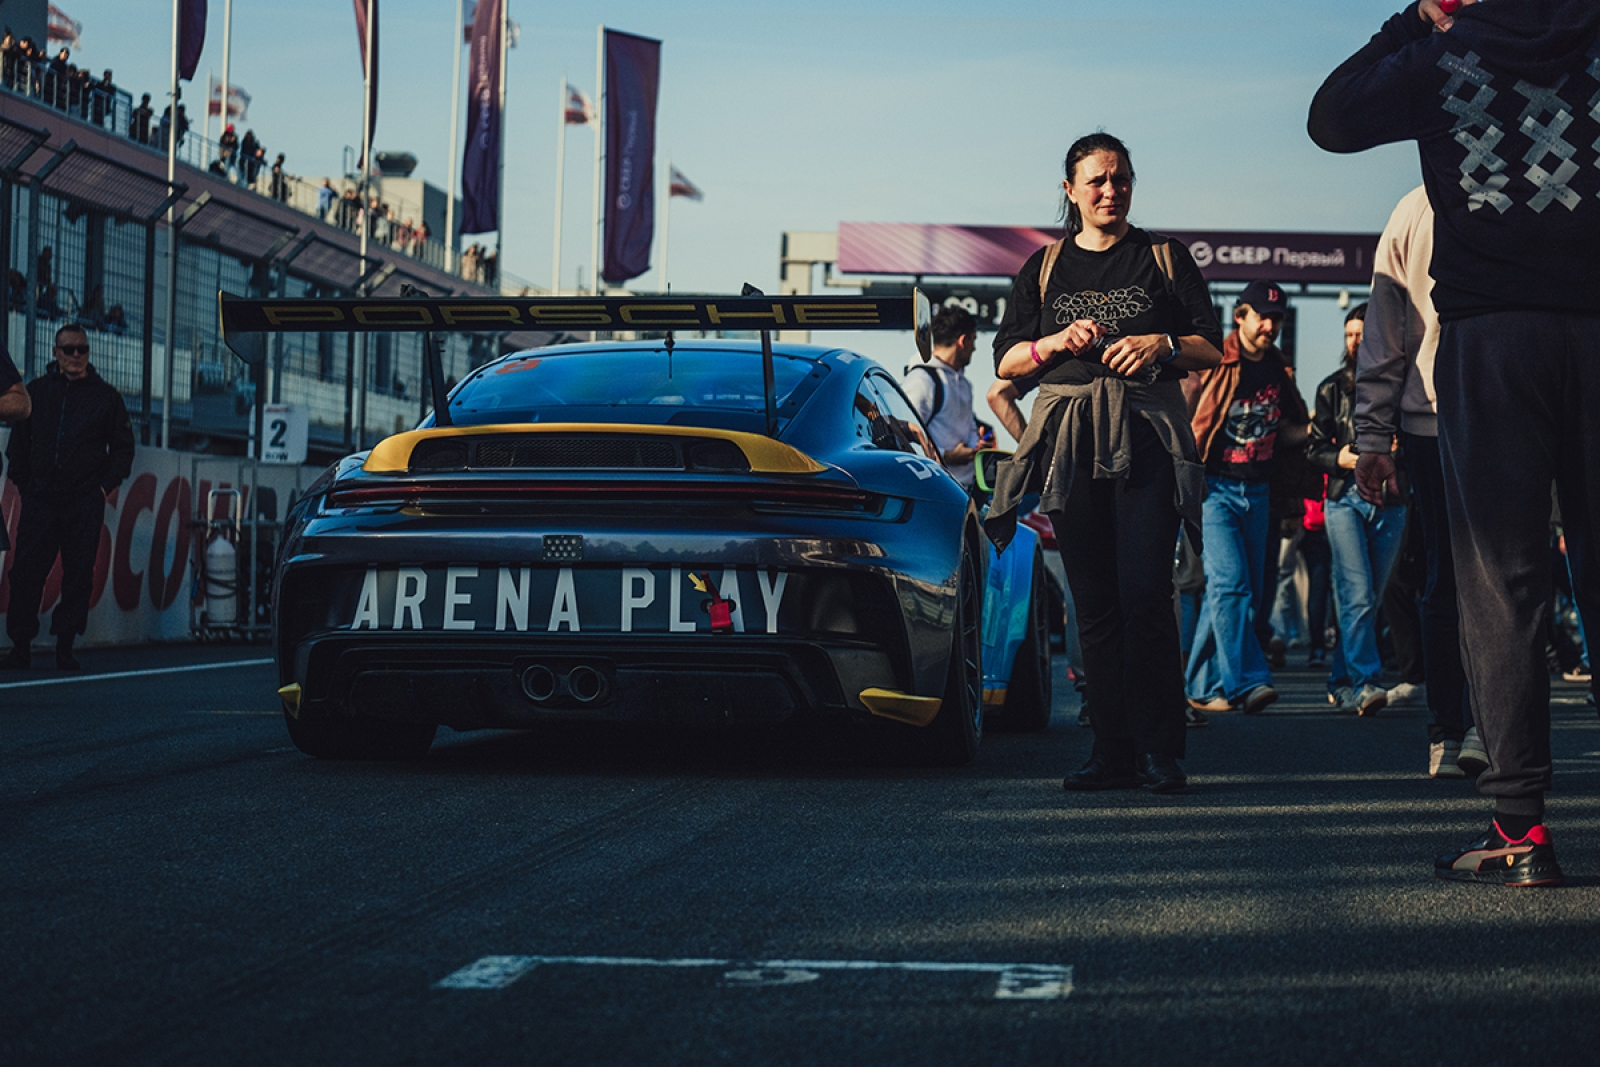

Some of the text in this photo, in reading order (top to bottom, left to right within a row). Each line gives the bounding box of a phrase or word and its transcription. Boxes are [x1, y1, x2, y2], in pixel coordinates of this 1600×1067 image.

[1215, 245, 1345, 269] СБЕР Первый
[261, 303, 881, 327] PORSCHE
[270, 419, 287, 447] 2
[351, 568, 789, 633] ARENA PLAY
